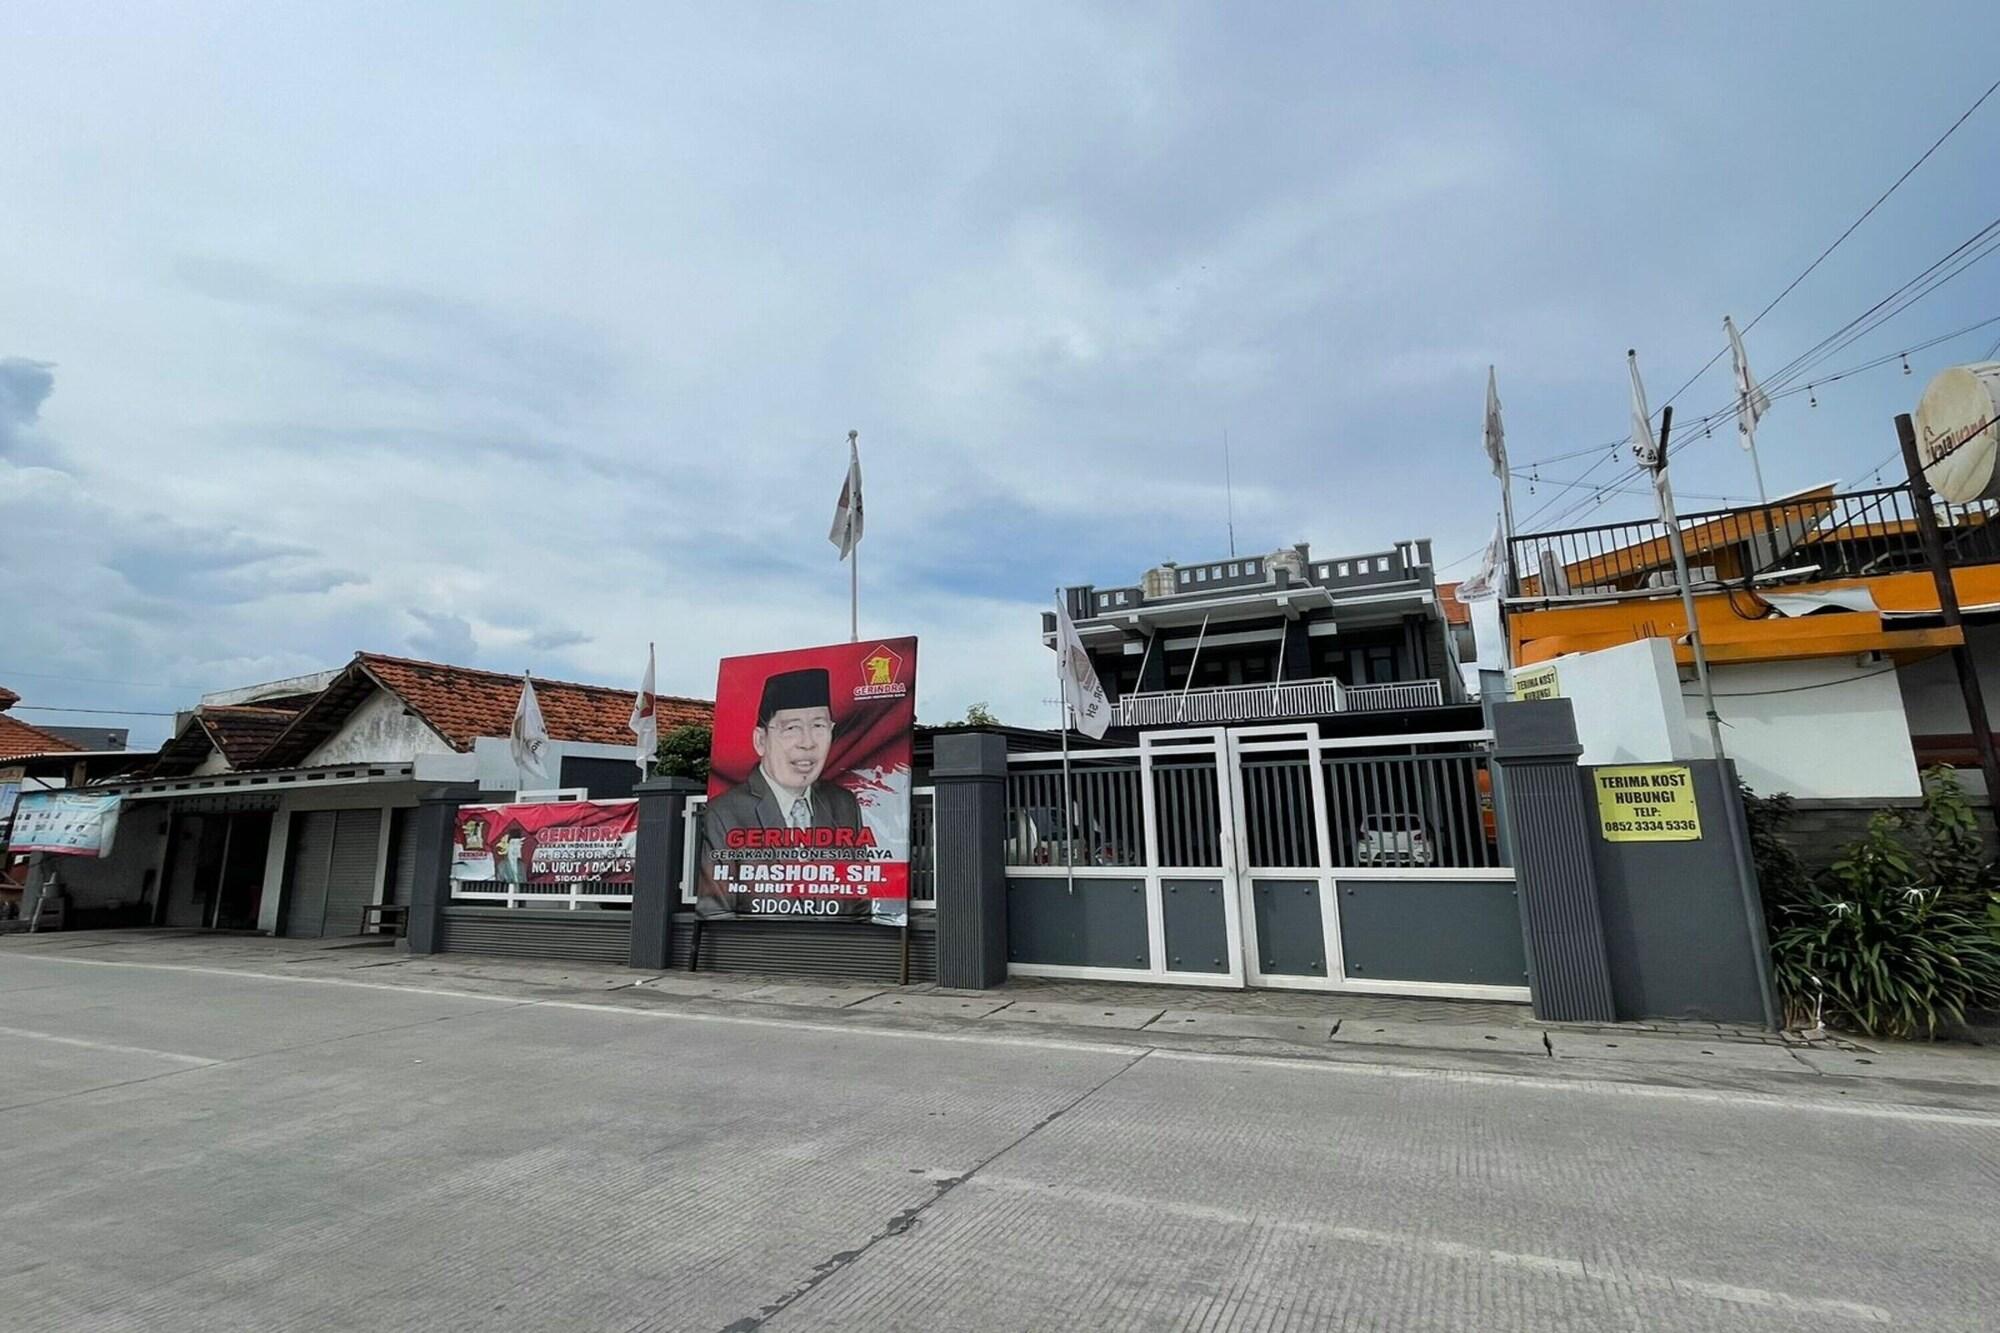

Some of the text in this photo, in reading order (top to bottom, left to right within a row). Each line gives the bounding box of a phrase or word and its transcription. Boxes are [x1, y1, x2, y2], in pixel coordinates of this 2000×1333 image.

[1516, 673, 1555, 691] TERIMA KOST
[853, 683, 906, 696] GERINDRA
[1600, 774, 1686, 789] TERIMA KOST
[1614, 791, 1675, 804] HUBUNGI
[1604, 820, 1696, 832] 0852 3334 5336
[536, 827, 622, 843] GERINDRA
[726, 826, 877, 848] GERINDRA
[711, 848, 893, 860] GERAKAN INDONESIA RAYA
[532, 862, 549, 873] NO.
[551, 862, 581, 873] URUT
[584, 862, 590, 873] 1
[624, 861, 632, 873] 5
[713, 865, 888, 883] H. BASHOR, SH.
[728, 883, 868, 894] No. URUT 1 DAPIL 5
[751, 899, 840, 915] SIDOARJO
